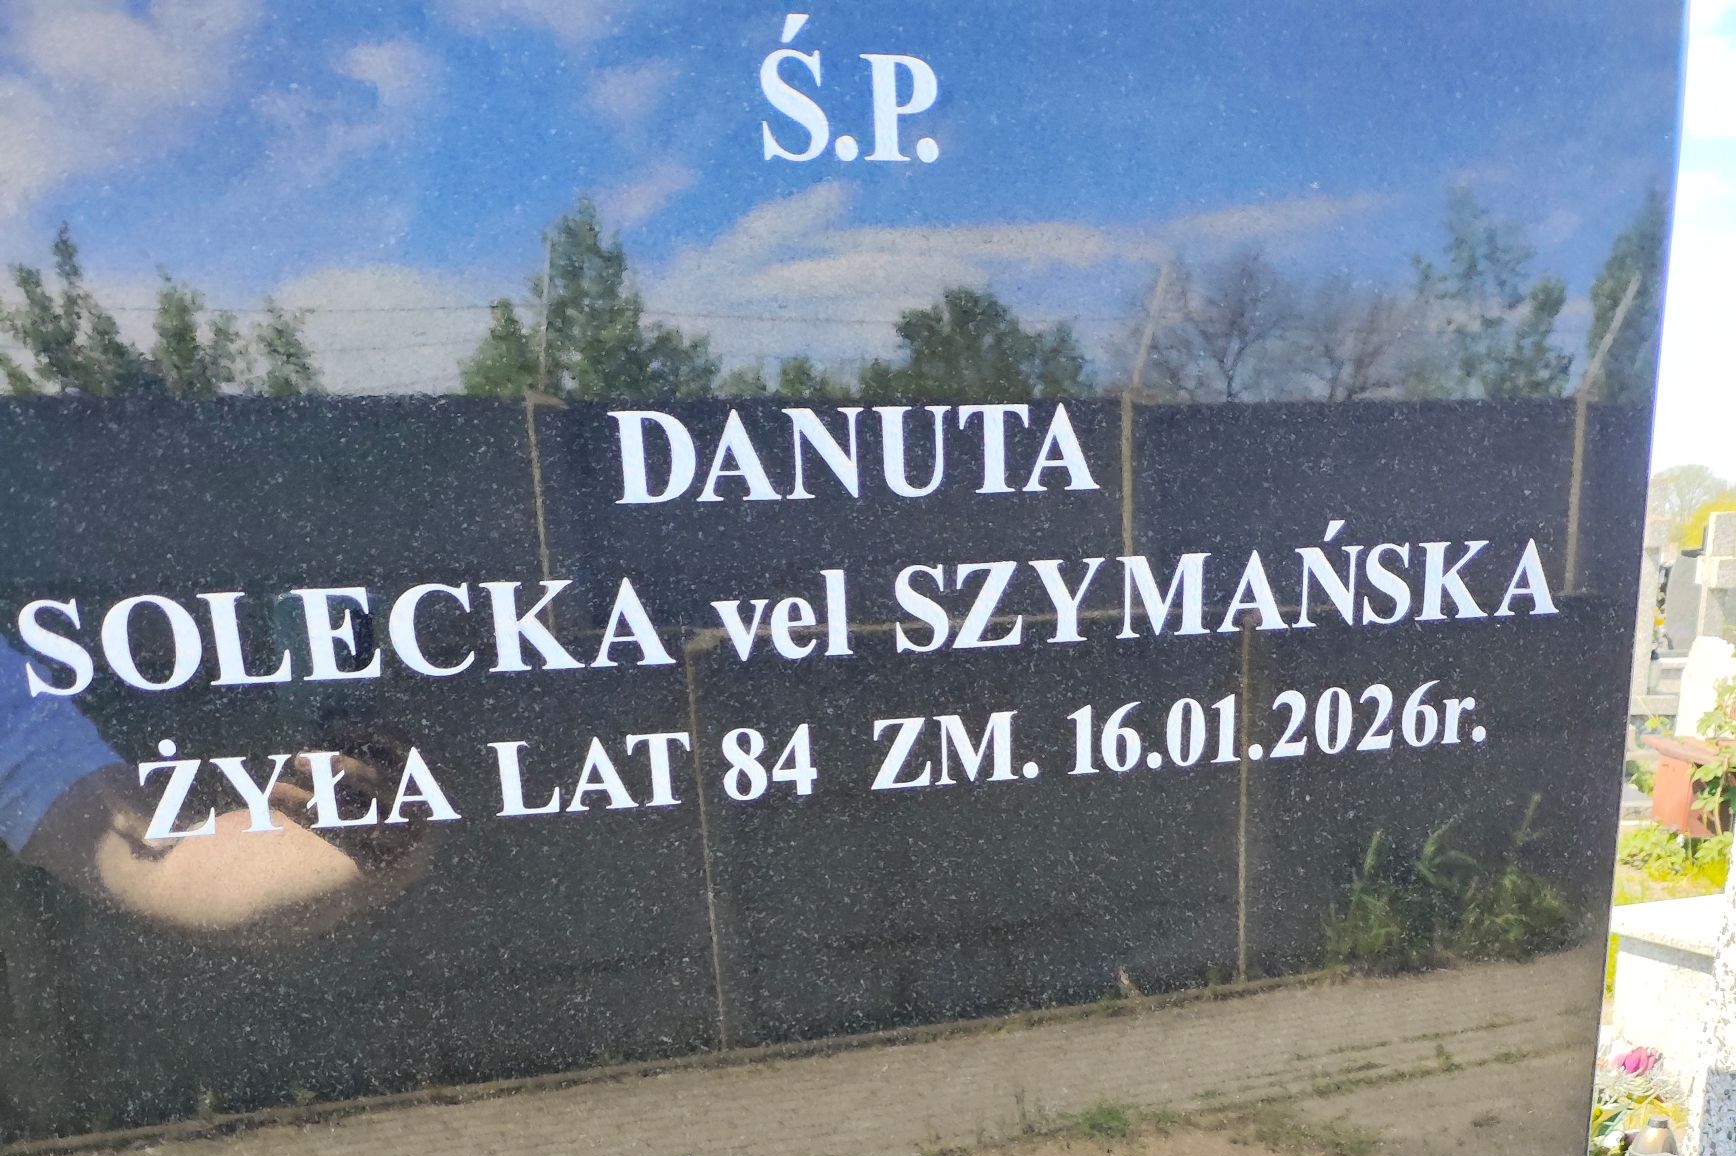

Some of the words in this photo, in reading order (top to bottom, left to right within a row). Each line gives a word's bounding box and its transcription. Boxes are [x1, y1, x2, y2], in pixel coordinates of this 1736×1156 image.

[760, 13, 939, 163] Ś.P.
[606, 402, 1100, 504] DANUTA
[18, 576, 677, 697] SOLECKA
[710, 569, 854, 662] vel
[894, 519, 1560, 653] SZYMAŃSKA
[138, 738, 462, 844] ŻYŁA
[487, 731, 691, 817] LAT
[721, 723, 818, 801] 84
[870, 710, 1039, 790] ZM.
[1066, 680, 1487, 775] 16.01.2026r.
